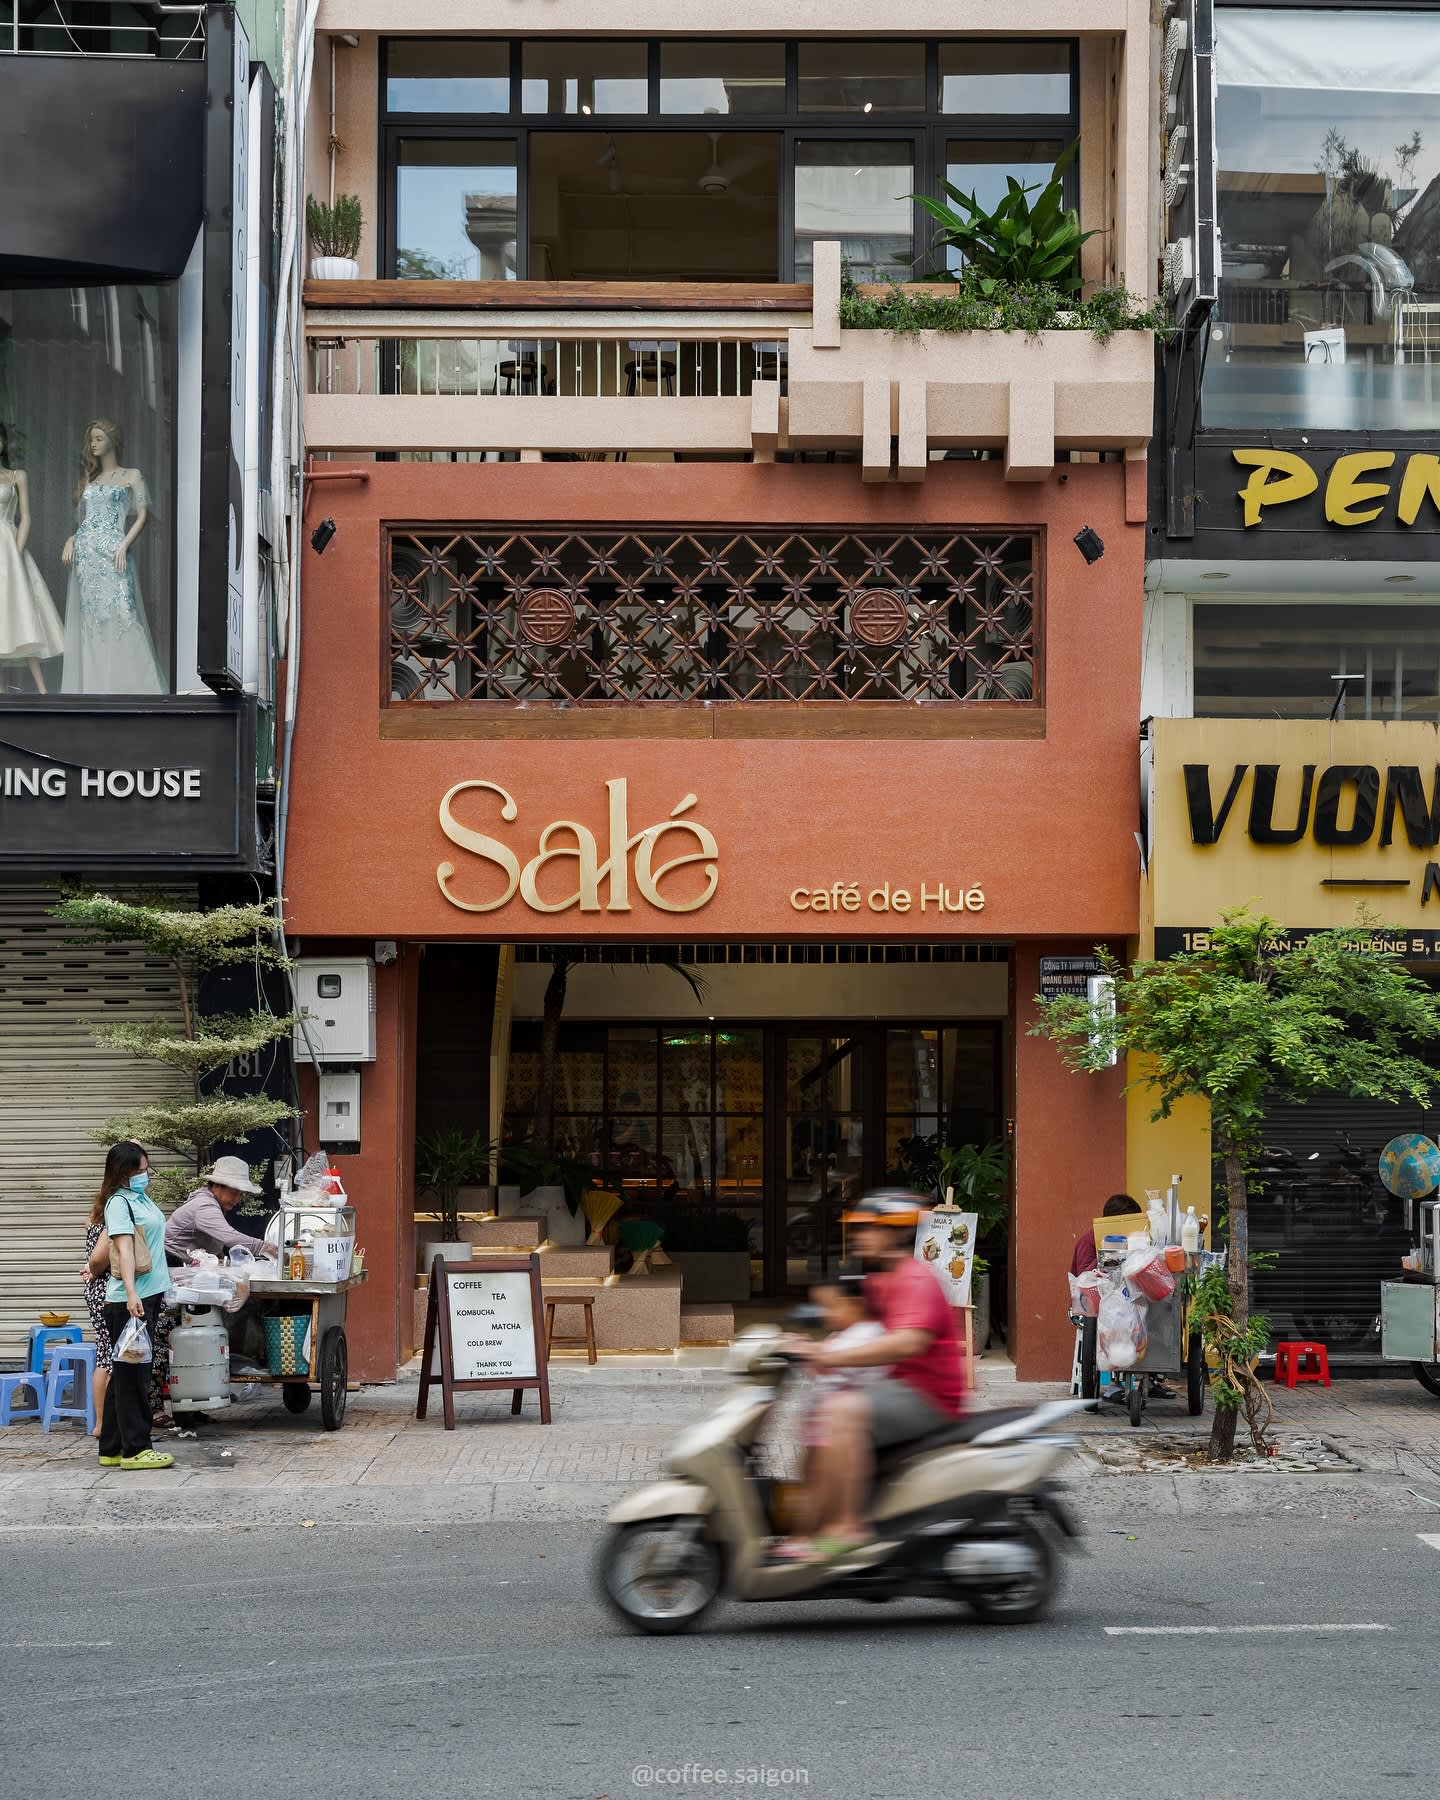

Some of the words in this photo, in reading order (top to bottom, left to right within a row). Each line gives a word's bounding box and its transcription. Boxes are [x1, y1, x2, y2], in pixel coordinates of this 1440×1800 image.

[229, 595, 241, 639] 181
[0, 767, 67, 797] ING
[81, 767, 201, 798] HOUSE
[436, 777, 719, 913] Salé
[790, 881, 862, 912] café
[867, 880, 912, 912] de
[920, 881, 985, 912] Hué
[1412, 939, 1431, 955] 5,
[227, 1050, 262, 1078] 181
[453, 1282, 482, 1290] COFFEE
[491, 1293, 506, 1301] TEA
